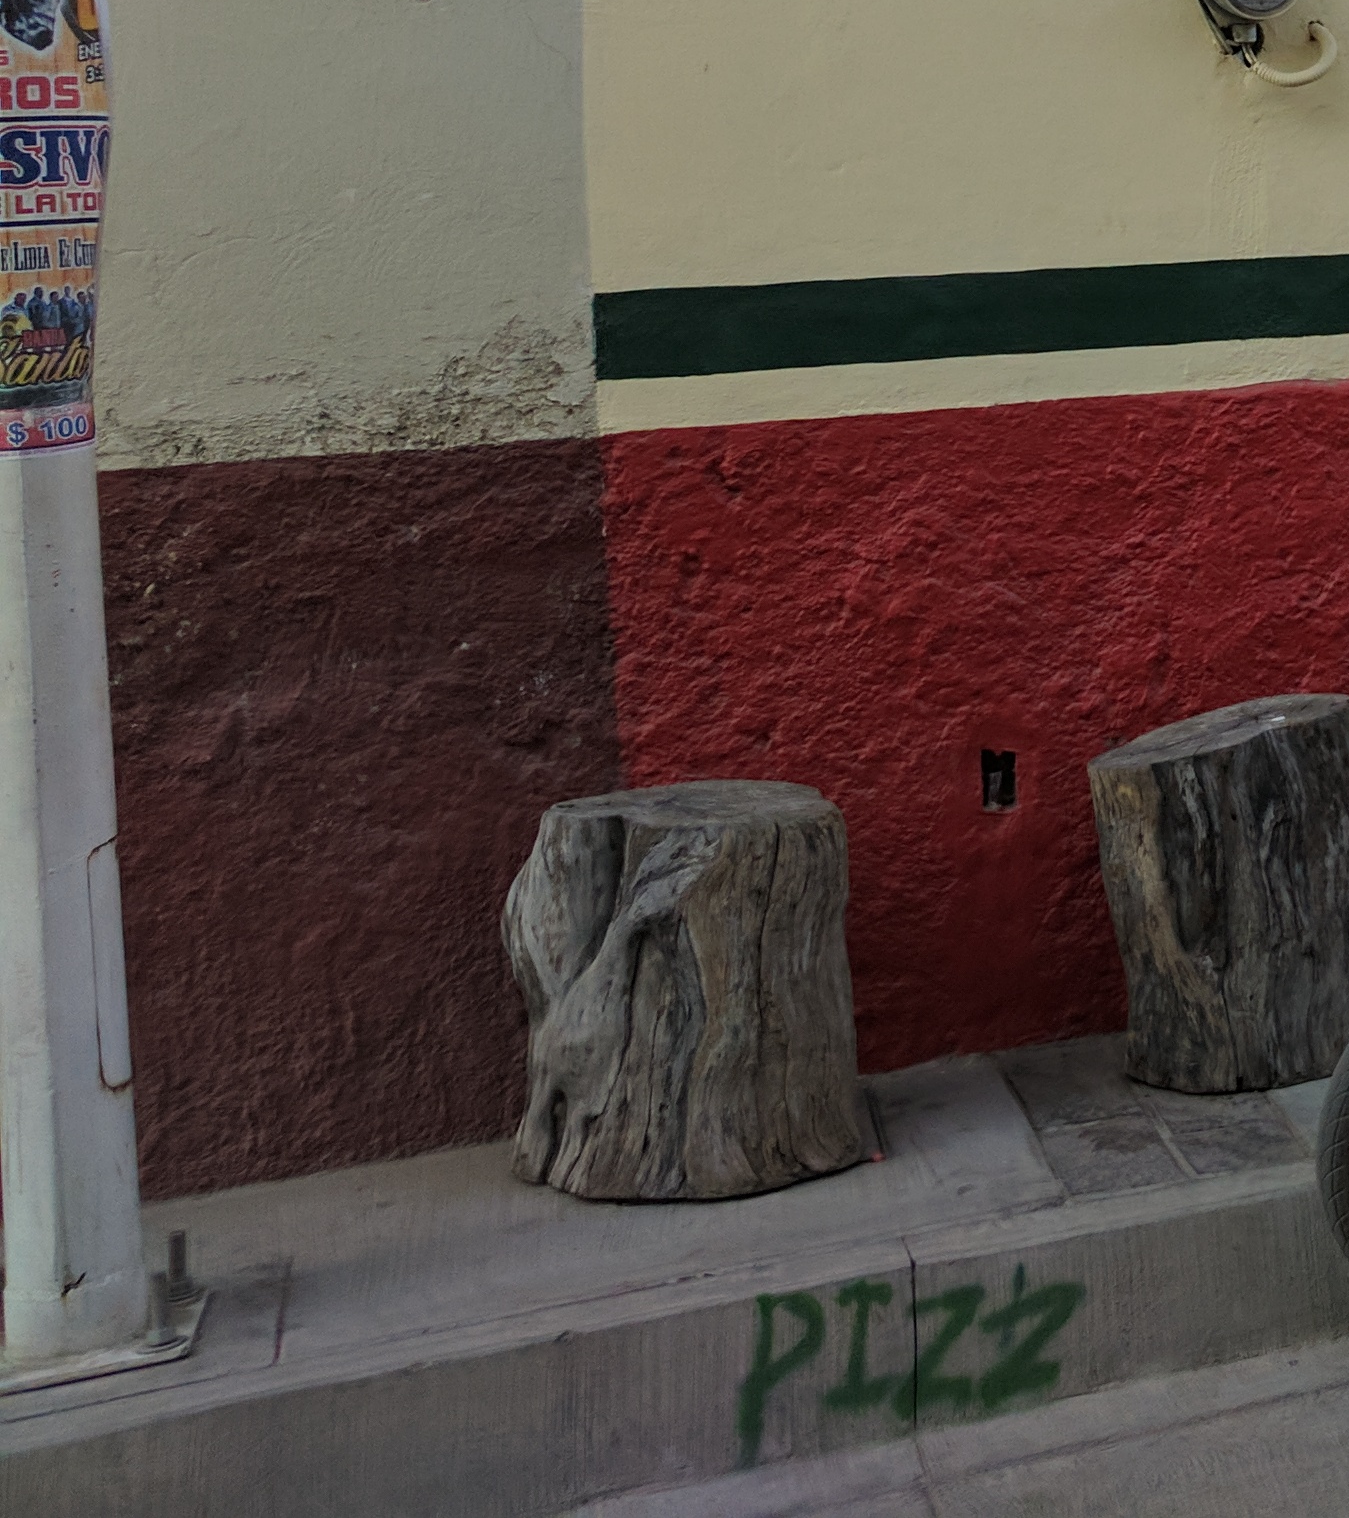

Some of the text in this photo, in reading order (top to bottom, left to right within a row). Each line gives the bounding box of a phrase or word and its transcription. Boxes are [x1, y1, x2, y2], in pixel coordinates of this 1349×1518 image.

[14, 193, 56, 214] LA
[8, 413, 88, 445] $ 100
